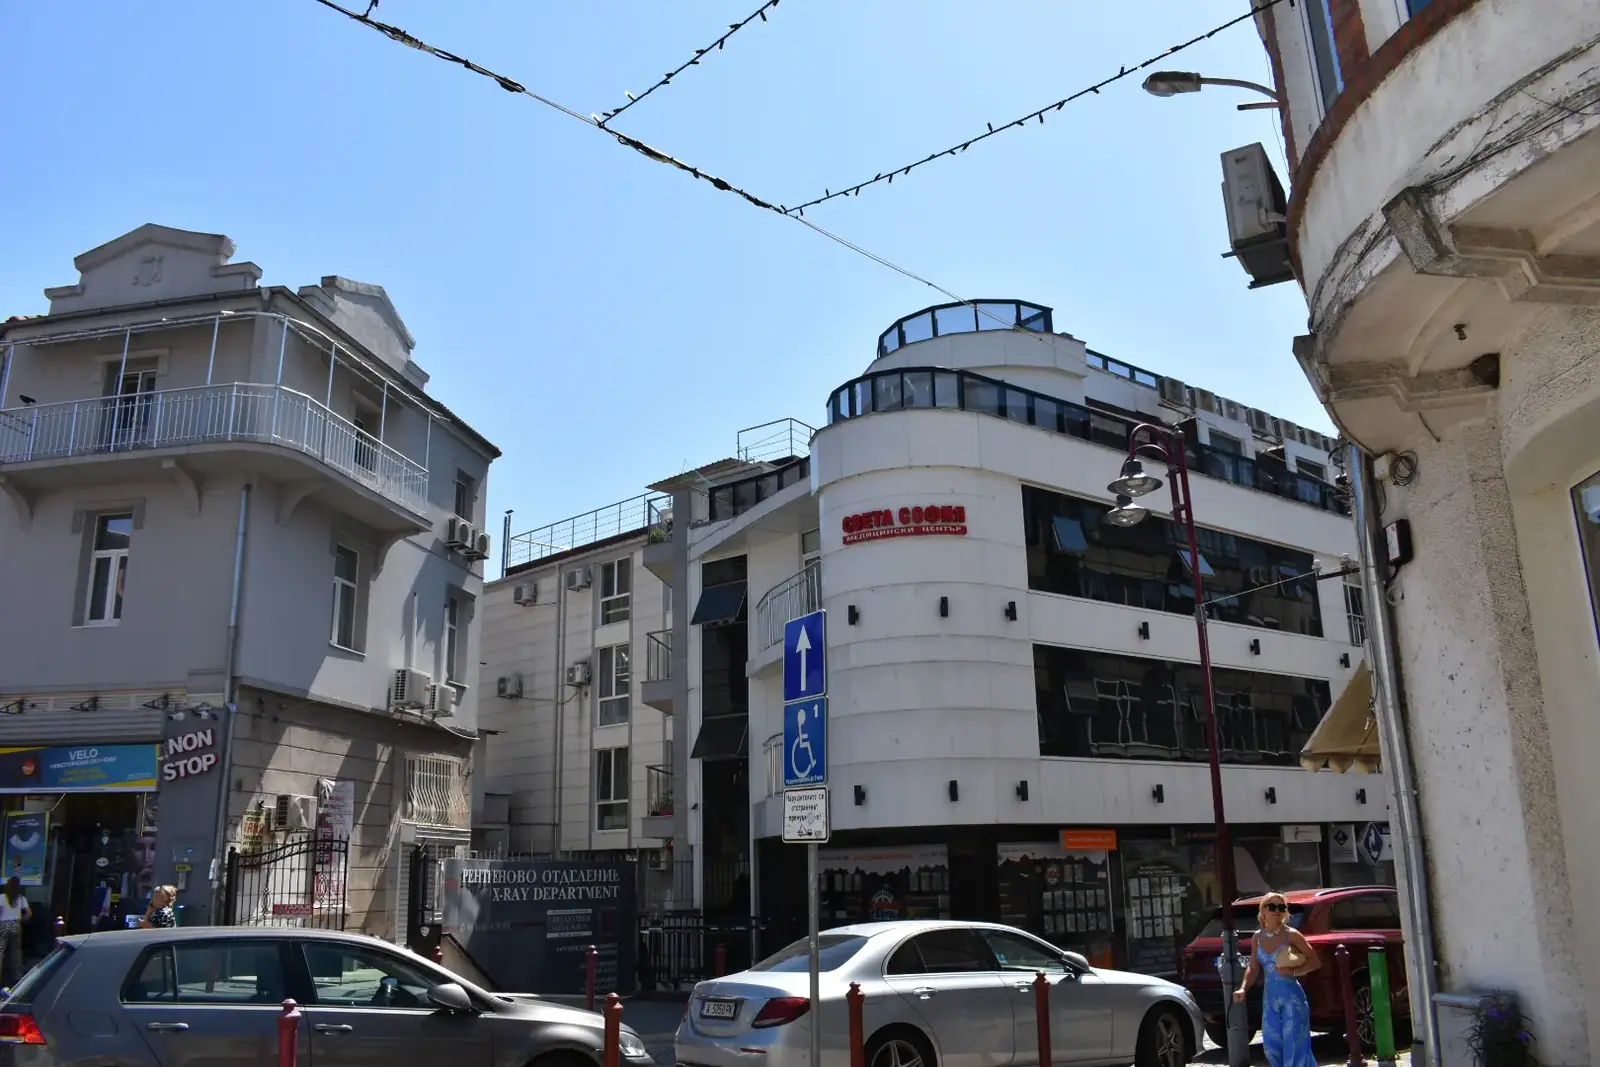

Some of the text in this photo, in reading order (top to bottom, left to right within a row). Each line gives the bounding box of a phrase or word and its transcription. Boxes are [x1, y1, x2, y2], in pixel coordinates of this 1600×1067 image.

[846, 527, 915, 542] МЕДИЦИНСКИ
[813, 704, 819, 718] 1
[168, 729, 212, 755] NON
[69, 748, 99, 760] VELO
[163, 754, 216, 780] STOP
[492, 885, 620, 901] X-RAY DEPARTMENT
